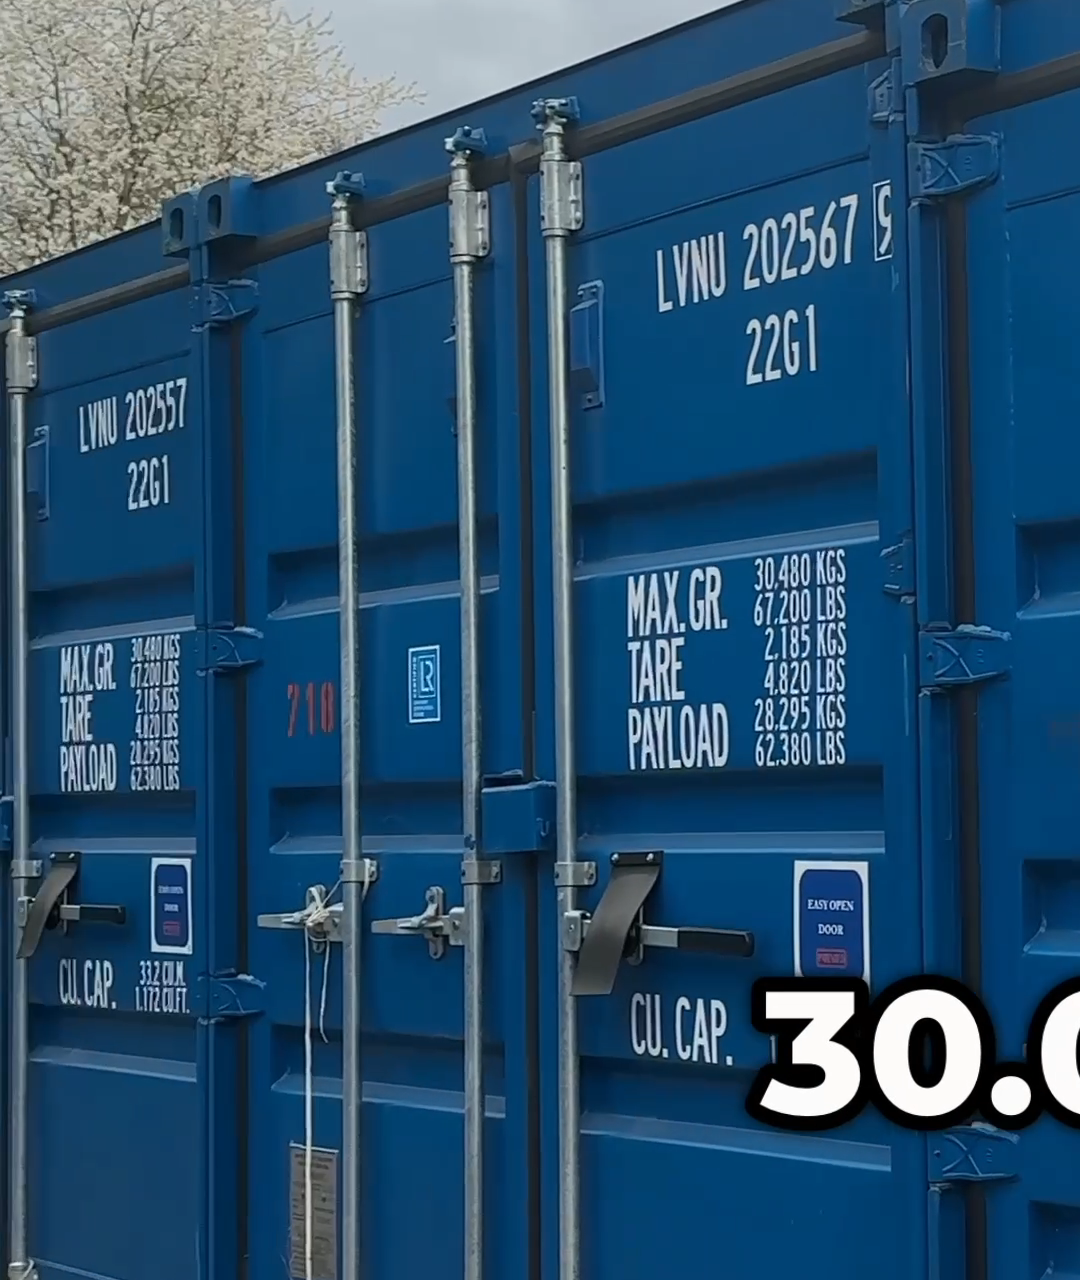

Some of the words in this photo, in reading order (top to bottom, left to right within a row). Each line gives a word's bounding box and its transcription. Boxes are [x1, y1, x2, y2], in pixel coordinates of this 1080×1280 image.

[656, 231, 727, 313] LVNU
[742, 194, 859, 291] 202567
[745, 303, 818, 386] 22G1
[79, 396, 118, 453] LVNU
[125, 377, 187, 440] 202557
[127, 454, 170, 511] 22G1
[815, 548, 847, 584] KGS
[815, 585, 846, 621] LBS
[815, 621, 847, 657] KGS
[627, 636, 685, 704] TARE
[815, 658, 846, 693] LBS
[60, 694, 93, 742] TARE
[627, 702, 730, 770] PAYLOAD
[815, 694, 846, 730] KGS
[60, 743, 117, 792] PAYLOAD
[815, 730, 846, 766] LBS
[807, 899, 829, 910] EASY
[829, 900, 854, 911] OPEN
[818, 923, 844, 935] DOOR
[631, 992, 669, 1058] CU.
[675, 996, 733, 1066] CAP.
